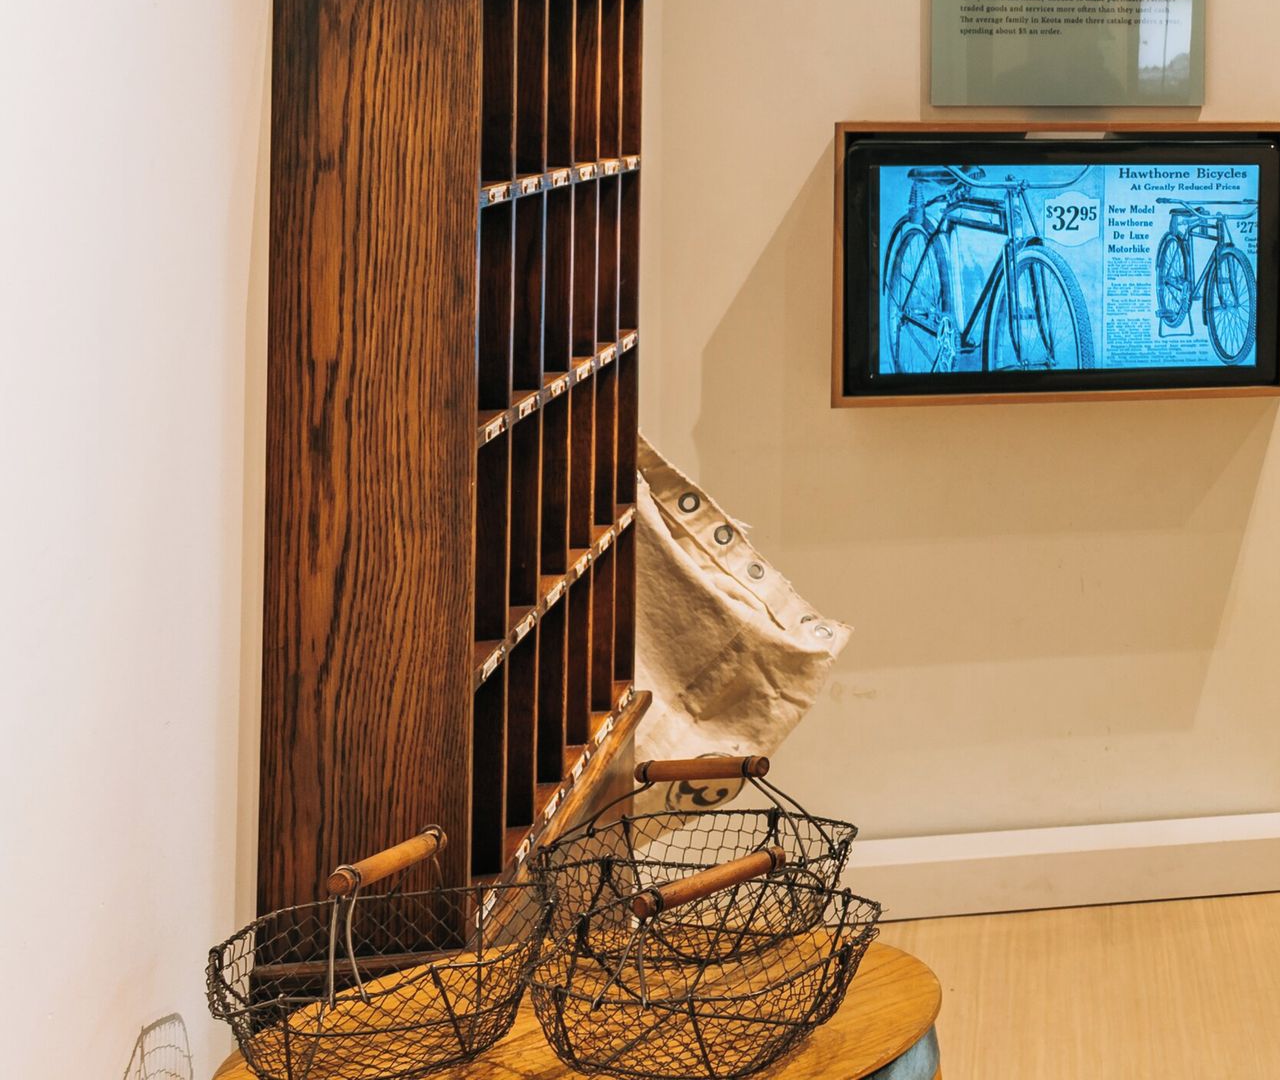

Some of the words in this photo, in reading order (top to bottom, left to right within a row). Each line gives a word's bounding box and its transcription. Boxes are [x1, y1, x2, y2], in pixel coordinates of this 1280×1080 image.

[960, 4, 984, 12] traded
[986, 4, 1007, 14] goods
[1009, 5, 1024, 13] and
[1025, 5, 1054, 13] services
[1077, 6, 1096, 14] often
[1098, 6, 1115, 14] than
[1117, 6, 1133, 16] they
[960, 15, 974, 23] The
[975, 17, 1003, 25] average
[1005, 16, 1029, 25] family
[1031, 16, 1039, 24] in
[1041, 16, 1061, 24] Keota
[1063, 16, 1083, 24] made
[1085, 17, 1104, 25] three
[1106, 17, 1132, 27] catalog
[960, 27, 994, 36] spending
[995, 27, 1017, 35] about
[1119, 168, 1190, 179] Hawthorne
[1196, 167, 1248, 180] Bicycles
[1144, 183, 1176, 192] Greatly
[1108, 205, 1126, 214] New
[1130, 205, 1155, 214] Model
[1108, 219, 1154, 227] Hawthorne
[1113, 231, 1125, 240] De
[1129, 231, 1149, 240] Luxe
[1108, 244, 1150, 254] Motorbike
